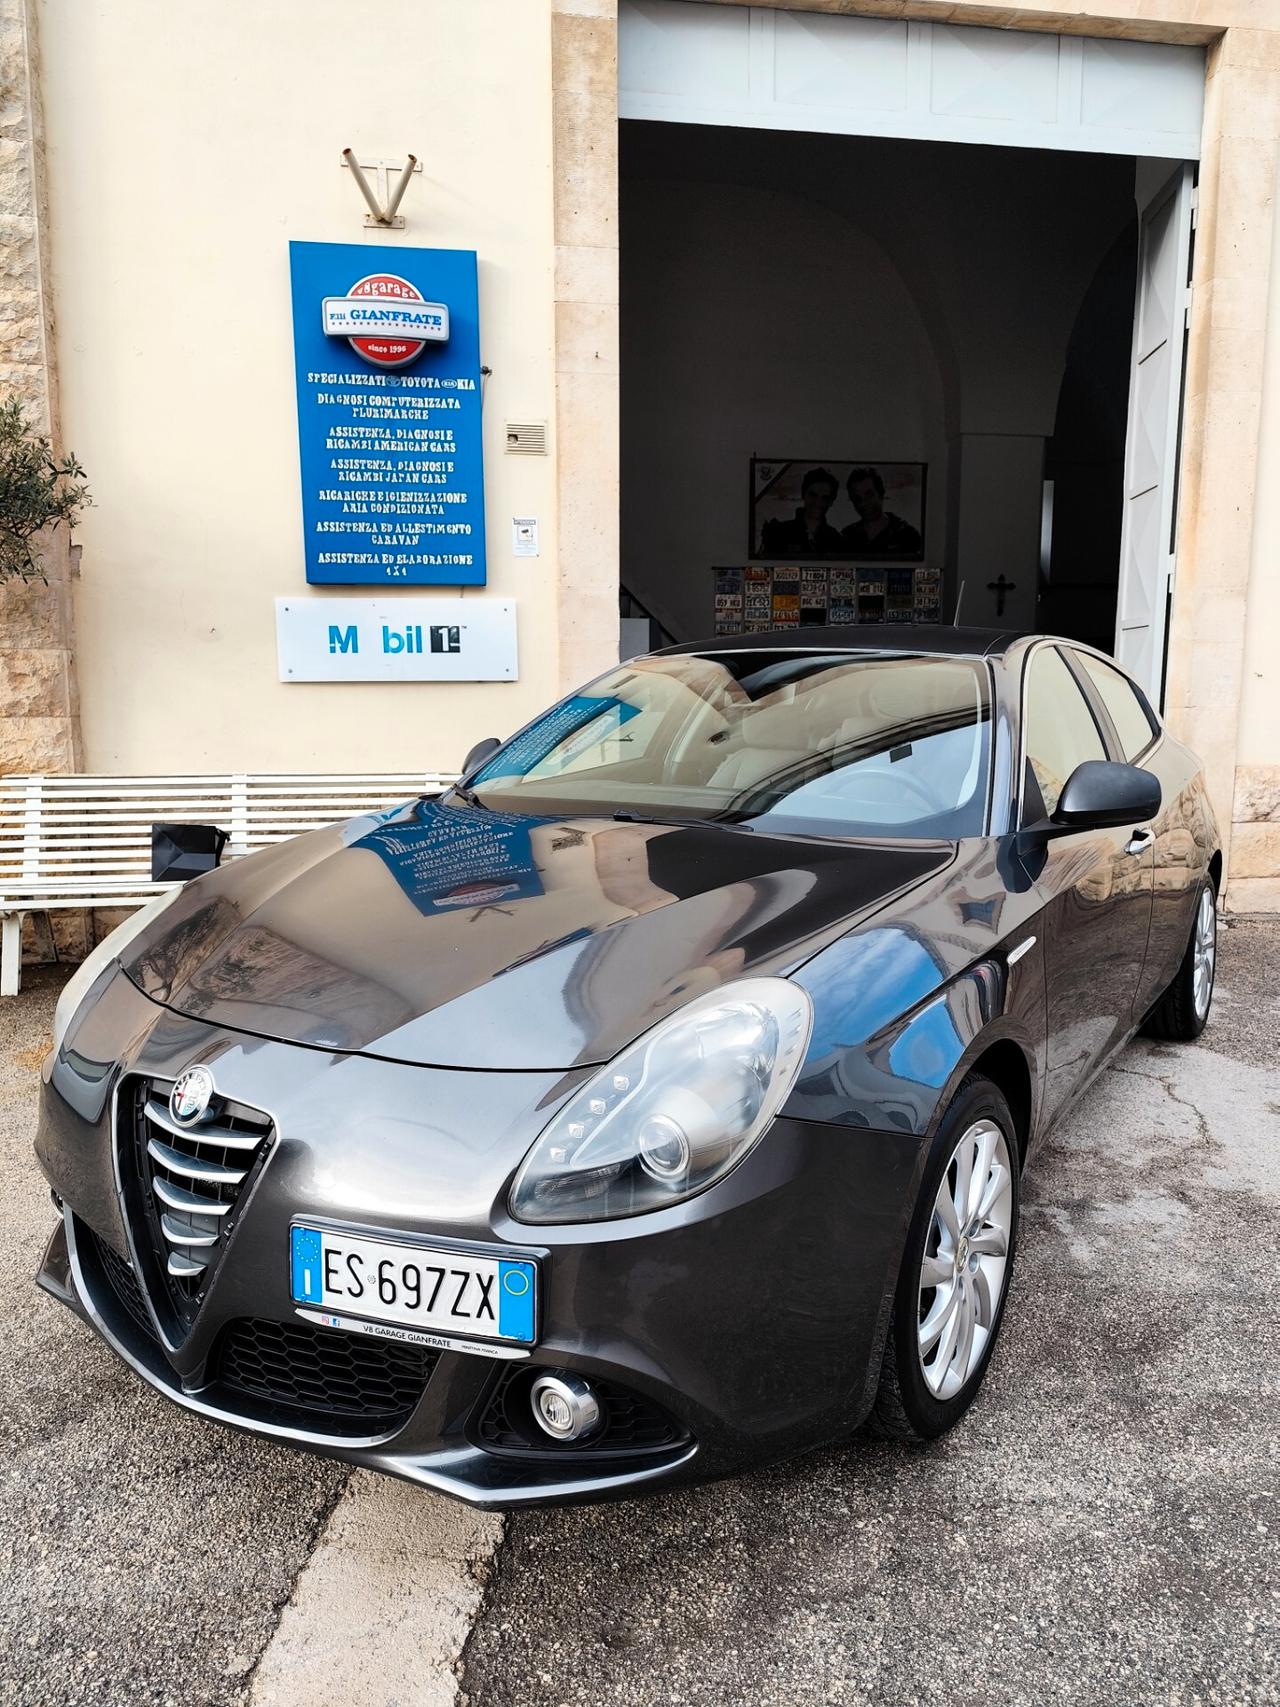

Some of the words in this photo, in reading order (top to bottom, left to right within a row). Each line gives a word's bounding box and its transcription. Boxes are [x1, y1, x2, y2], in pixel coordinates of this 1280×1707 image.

[349, 309, 442, 326] GIANFRATE
[308, 373, 386, 386] SPECIALIZZATI
[401, 377, 440, 388] TOYOTA
[457, 379, 475, 390] KIA
[318, 393, 367, 405] DIAGNOSI
[369, 395, 460, 409] COMPUTERIZZATA
[353, 407, 428, 419] PLURIMARCHE
[397, 429, 445, 440] DIAGNOSI
[447, 430, 453, 440] E
[326, 439, 372, 449] RICAMBI
[374, 440, 428, 451] AMERICAN
[430, 442, 456, 452] CARS
[398, 461, 445, 471] DIAGNOSI
[447, 462, 454, 472] E
[339, 471, 383, 482] RICAMBI
[385, 473, 419, 483] JAPAN
[421, 473, 447, 484] CARS
[319, 490, 376, 501] RICARICHE
[377, 491, 384, 501] E
[386, 492, 467, 503] IGIENIZZAZIONE
[343, 503, 368, 513] ARIA
[371, 503, 444, 514] CONDIZIONATA
[317, 522, 378, 533] ASSISTENZA
[381, 523, 392, 532] ED
[395, 523, 471, 534] ALLESTIMENTO
[372, 535, 419, 545] CARAVAN
[318, 553, 380, 563] ASSISTENZA
[382, 554, 394, 563] ED
[397, 554, 473, 565] ELABORAZIONE
[325, 1248, 364, 1298] ES
[378, 1260, 495, 1320] 697ZX
[363, 1325, 374, 1333] V8
[375, 1327, 406, 1340] GARAGE
[407, 1333, 451, 1348] GIANFRATE
